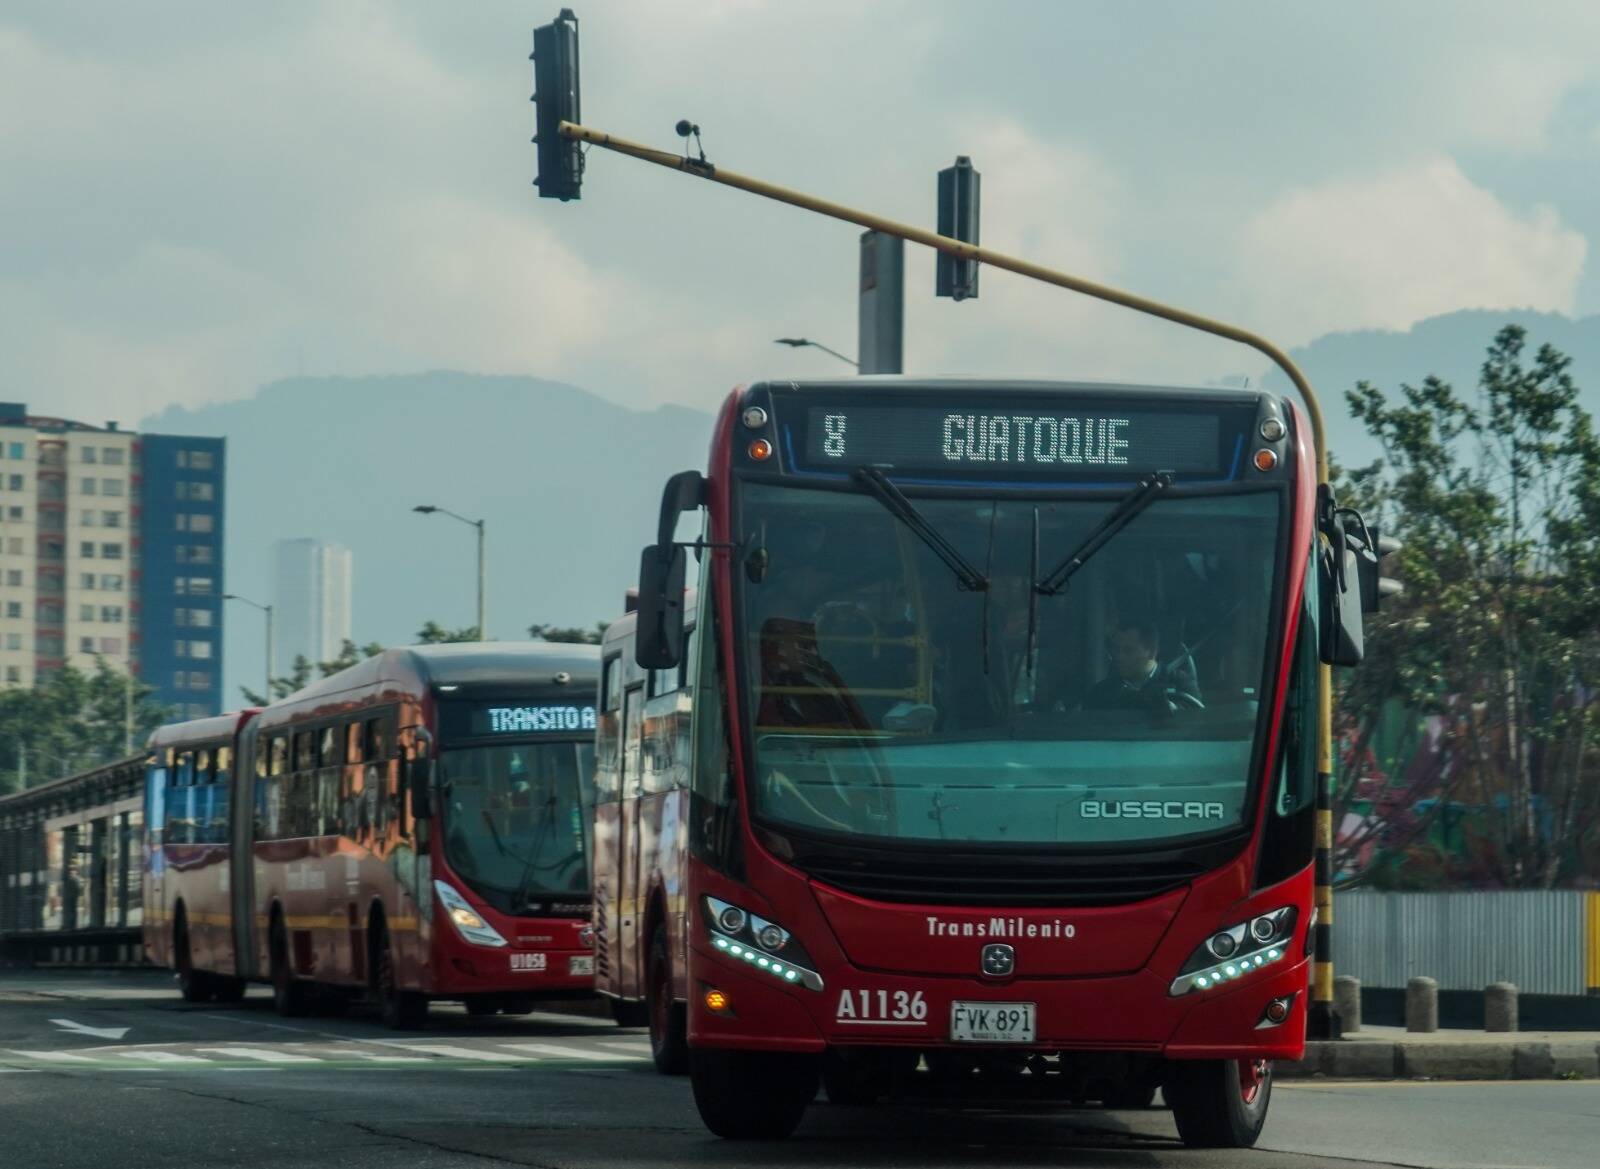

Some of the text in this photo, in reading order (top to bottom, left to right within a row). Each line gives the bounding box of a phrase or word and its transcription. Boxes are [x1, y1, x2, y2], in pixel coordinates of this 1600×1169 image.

[824, 414, 1130, 464] 8 GUATOQUE
[488, 707, 580, 731] TRANSITO
[1080, 801, 1224, 819] BUSSCAR
[927, 917, 1076, 937] TransMilenio
[836, 989, 928, 1020] A1136
